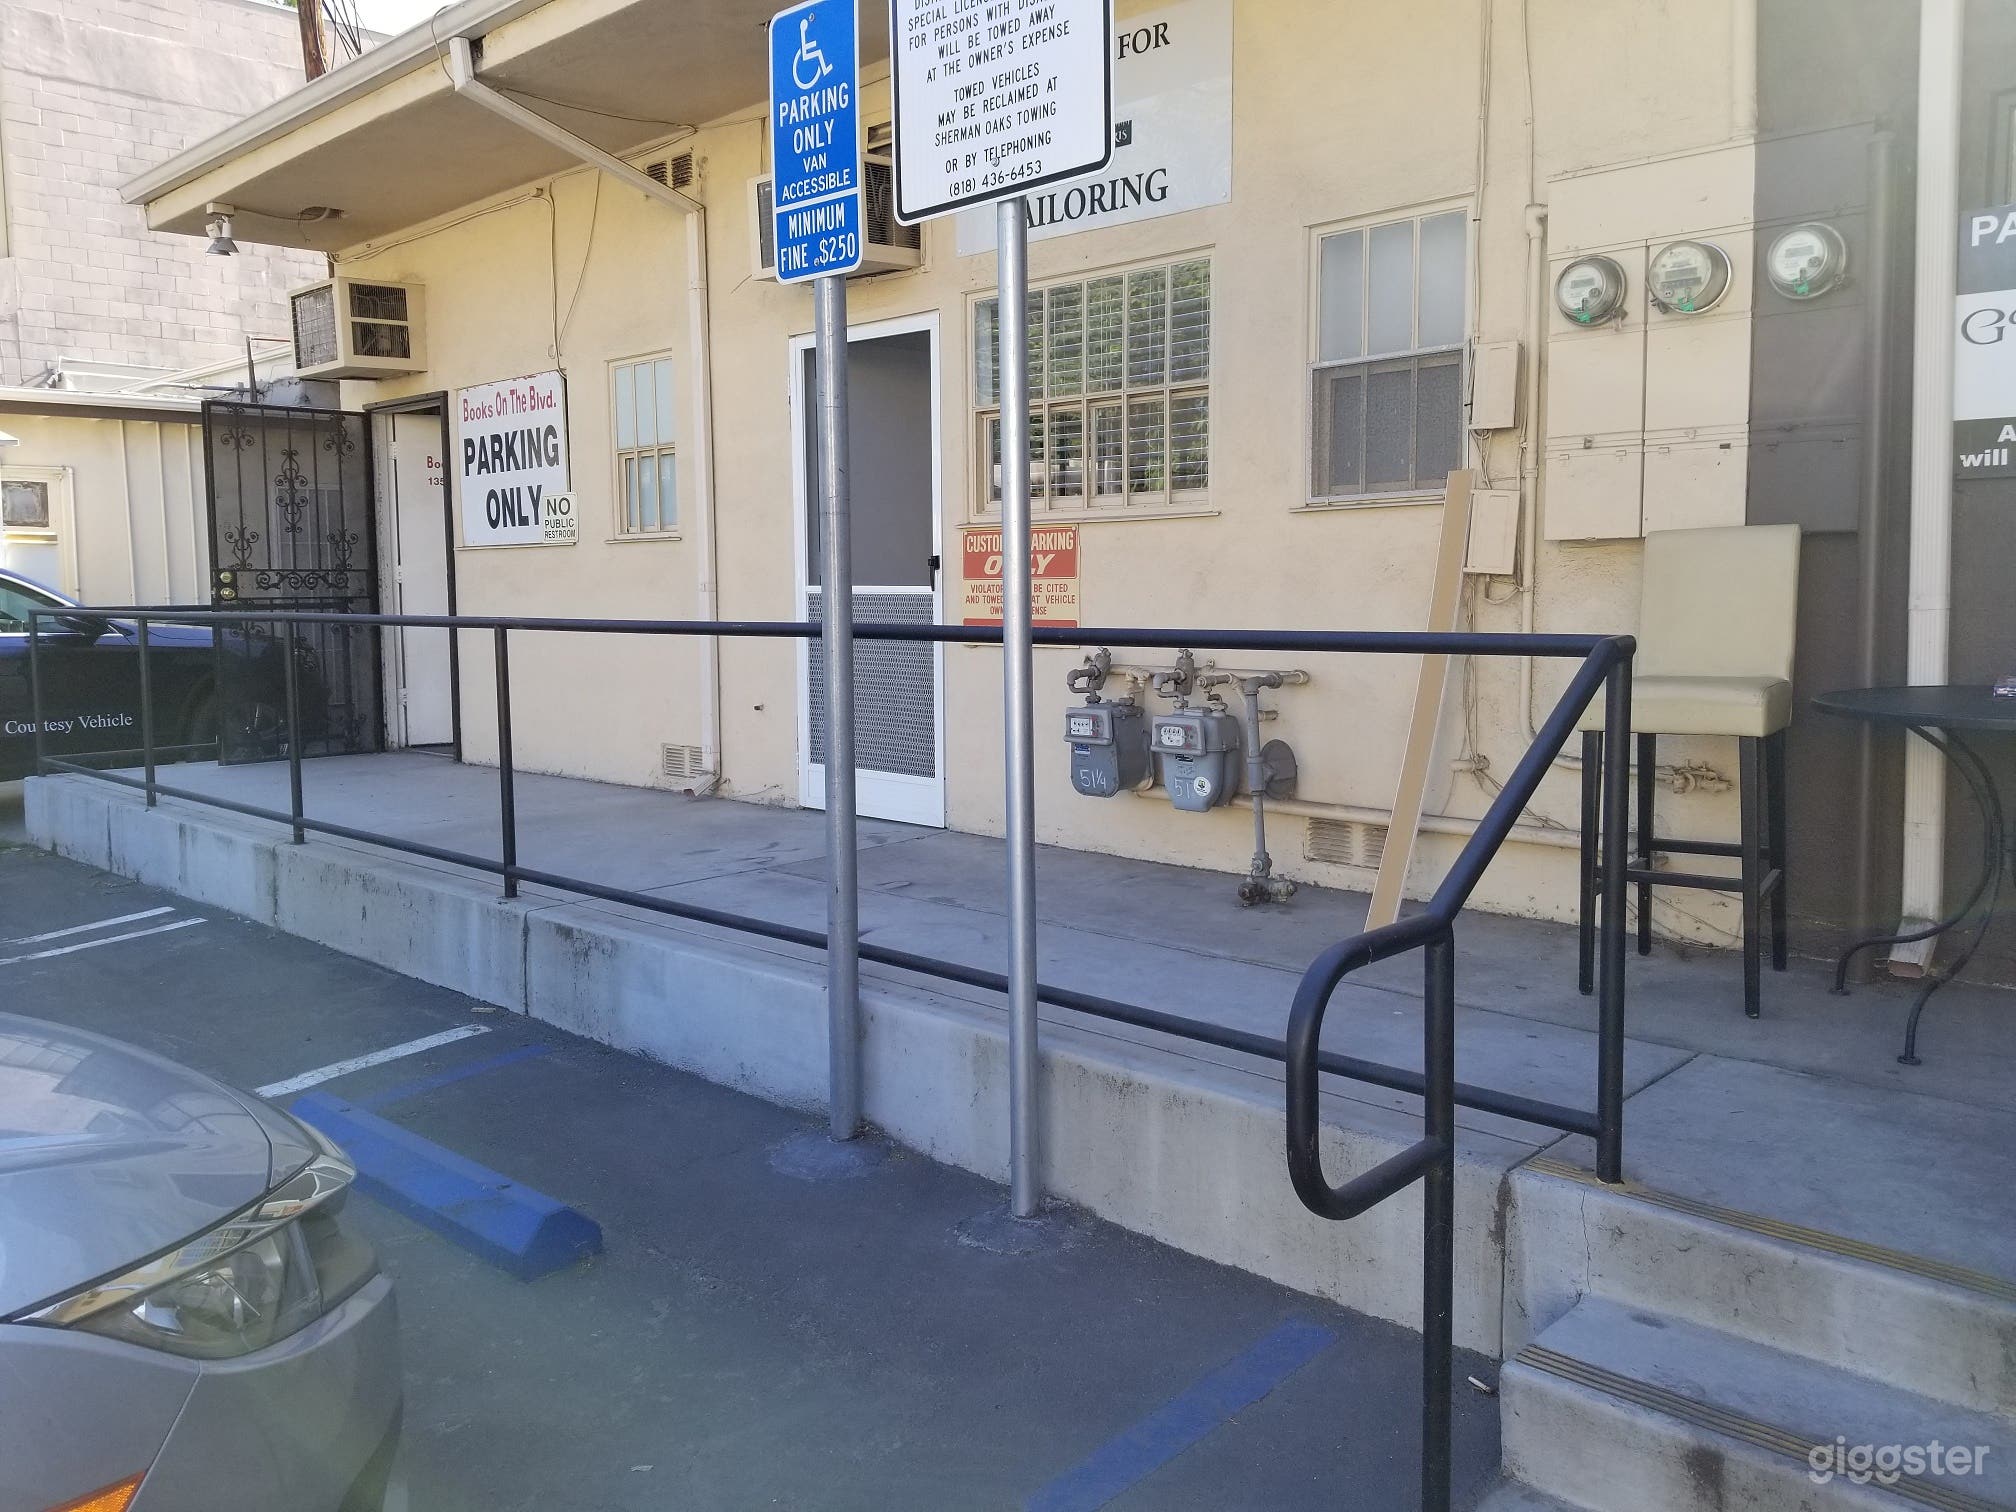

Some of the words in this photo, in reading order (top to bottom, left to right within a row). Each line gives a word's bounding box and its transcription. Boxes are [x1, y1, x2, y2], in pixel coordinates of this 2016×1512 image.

[908, 5, 947, 31] SPECIAL
[909, 33, 927, 51] FOR
[934, 13, 979, 42] PERSONS
[986, 1, 1010, 22] WITH
[938, 39, 961, 59] WILL
[968, 32, 981, 49] BE
[987, 17, 1021, 41] TOWED
[1029, 4, 1055, 28] AWAY
[926, 67, 937, 83] AT
[943, 59, 961, 77] THE
[968, 40, 1014, 68] OWNER'S
[1022, 20, 1070, 50] EXPENSE
[1117, 22, 1170, 60] FOR
[954, 81, 985, 103] TOWED
[992, 62, 1040, 90] VEHICLES
[779, 82, 849, 127] PARKING
[938, 109, 956, 127] MAY
[963, 103, 976, 119] BE
[983, 83, 1039, 113] RECLAIMED
[1046, 76, 1058, 93] AT
[793, 119, 834, 154] ONLY
[935, 123, 981, 147] SHERMAN
[985, 115, 1012, 135] OAKS
[1017, 101, 1057, 126] TOWING
[803, 152, 827, 173] VAN
[945, 158, 958, 174] OR
[965, 152, 977, 168] BY
[984, 130, 1052, 163] TELEPHONING
[782, 168, 851, 201] ACCESSIBLE
[949, 178, 976, 197] (818)
[981, 160, 1042, 188] 436-6453
[1026, 168, 1169, 229] AILORING
[788, 202, 845, 239] MINIMUM
[780, 243, 809, 272] FINE
[819, 232, 855, 267] $250
[463, 399, 493, 422] Books
[495, 391, 508, 416] On
[509, 389, 527, 413] The
[529, 385, 557, 412] Blvd.
[463, 424, 559, 476] PARKING
[1960, 448, 2008, 467] will
[486, 485, 543, 529] ONLY
[545, 518, 575, 529] PUBLIC
[547, 497, 571, 516] NO
[545, 530, 576, 539] RESTROOM
[1031, 532, 1073, 551] ARKING
[966, 595, 979, 604] AND
[1045, 594, 1076, 604] VEHICLE
[1034, 583, 1043, 593] BE
[1046, 583, 1068, 593] CITED
[5, 720, 74, 734] Coutesy
[78, 713, 134, 729] Vehicle
